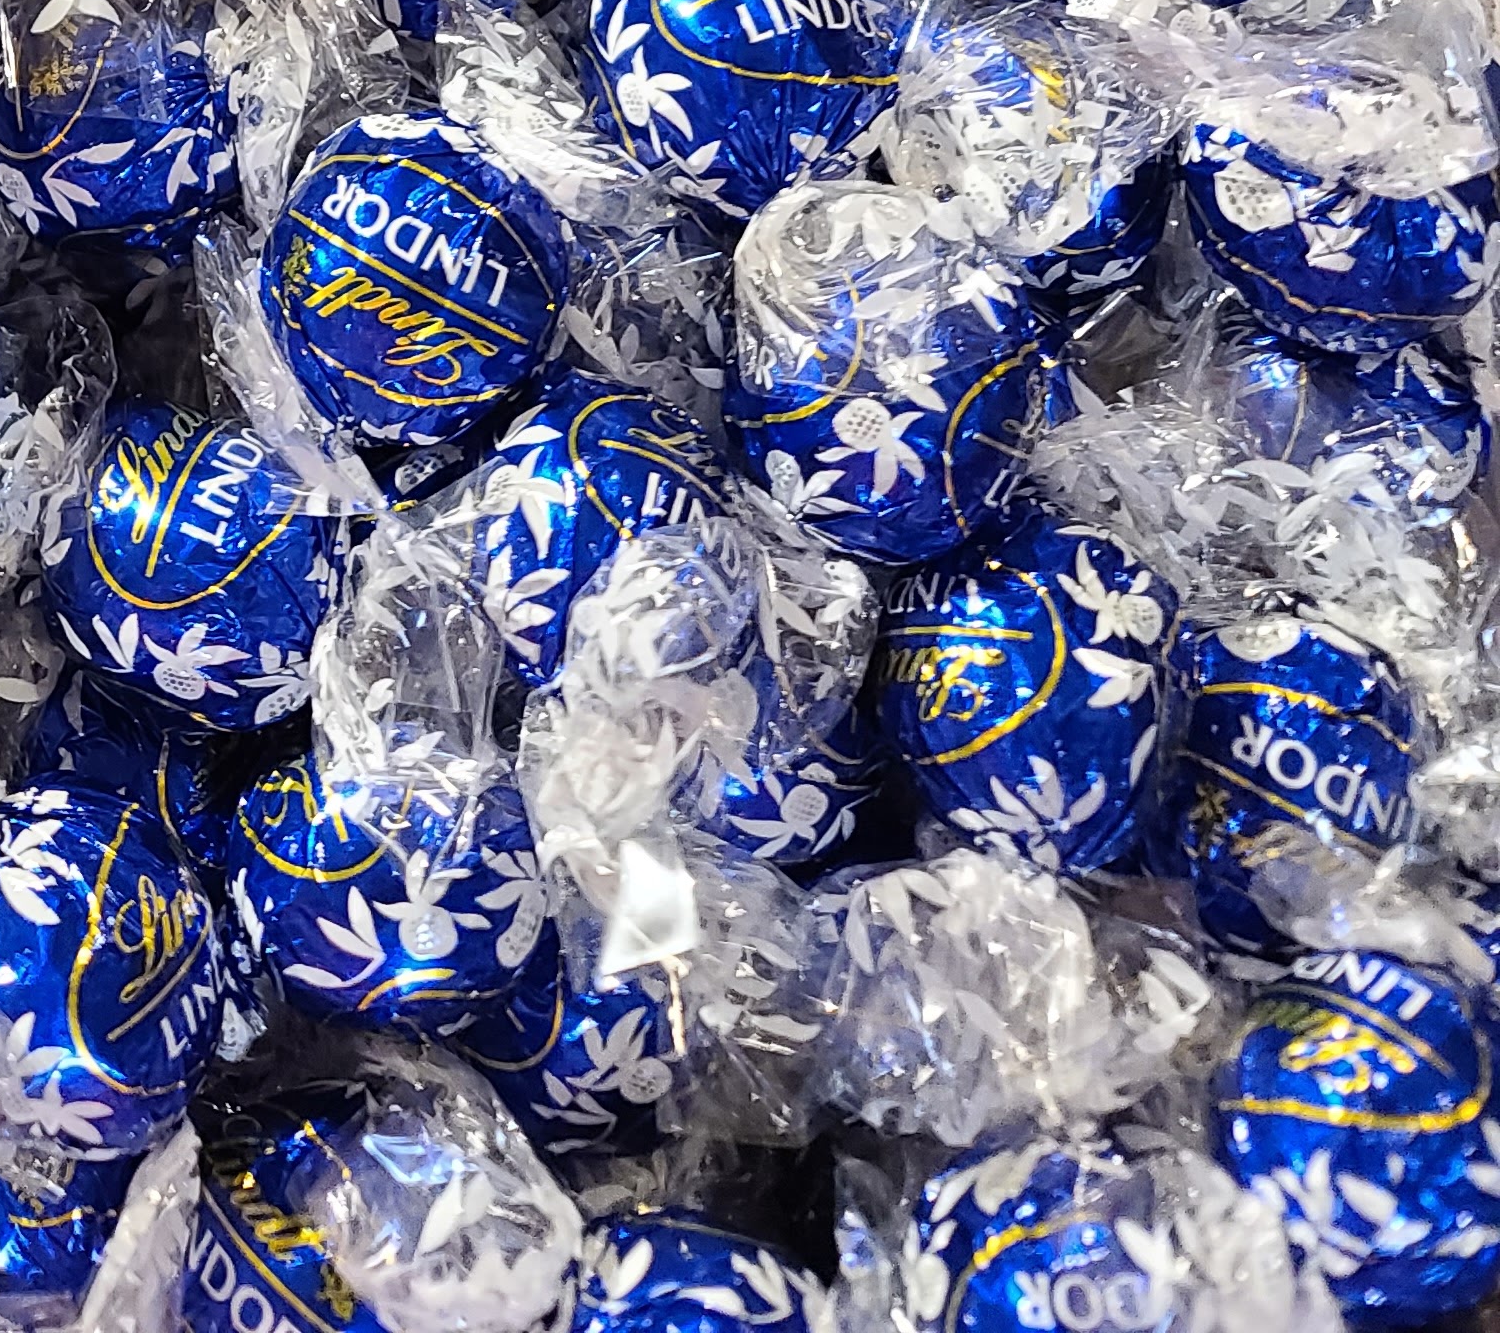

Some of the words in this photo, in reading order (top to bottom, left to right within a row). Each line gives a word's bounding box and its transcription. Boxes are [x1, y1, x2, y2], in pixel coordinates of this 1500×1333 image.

[322, 174, 510, 308] LINDOR
[303, 266, 500, 386] Lindt
[98, 408, 212, 544] Lind
[179, 426, 274, 549] LIND
[884, 571, 997, 618] LIND
[113, 873, 204, 1005] Lin
[1295, 950, 1435, 1022] LIND
[159, 965, 239, 1061] LIN
[187, 1226, 302, 1333] NDO
[1015, 1265, 1152, 1333] DOR
